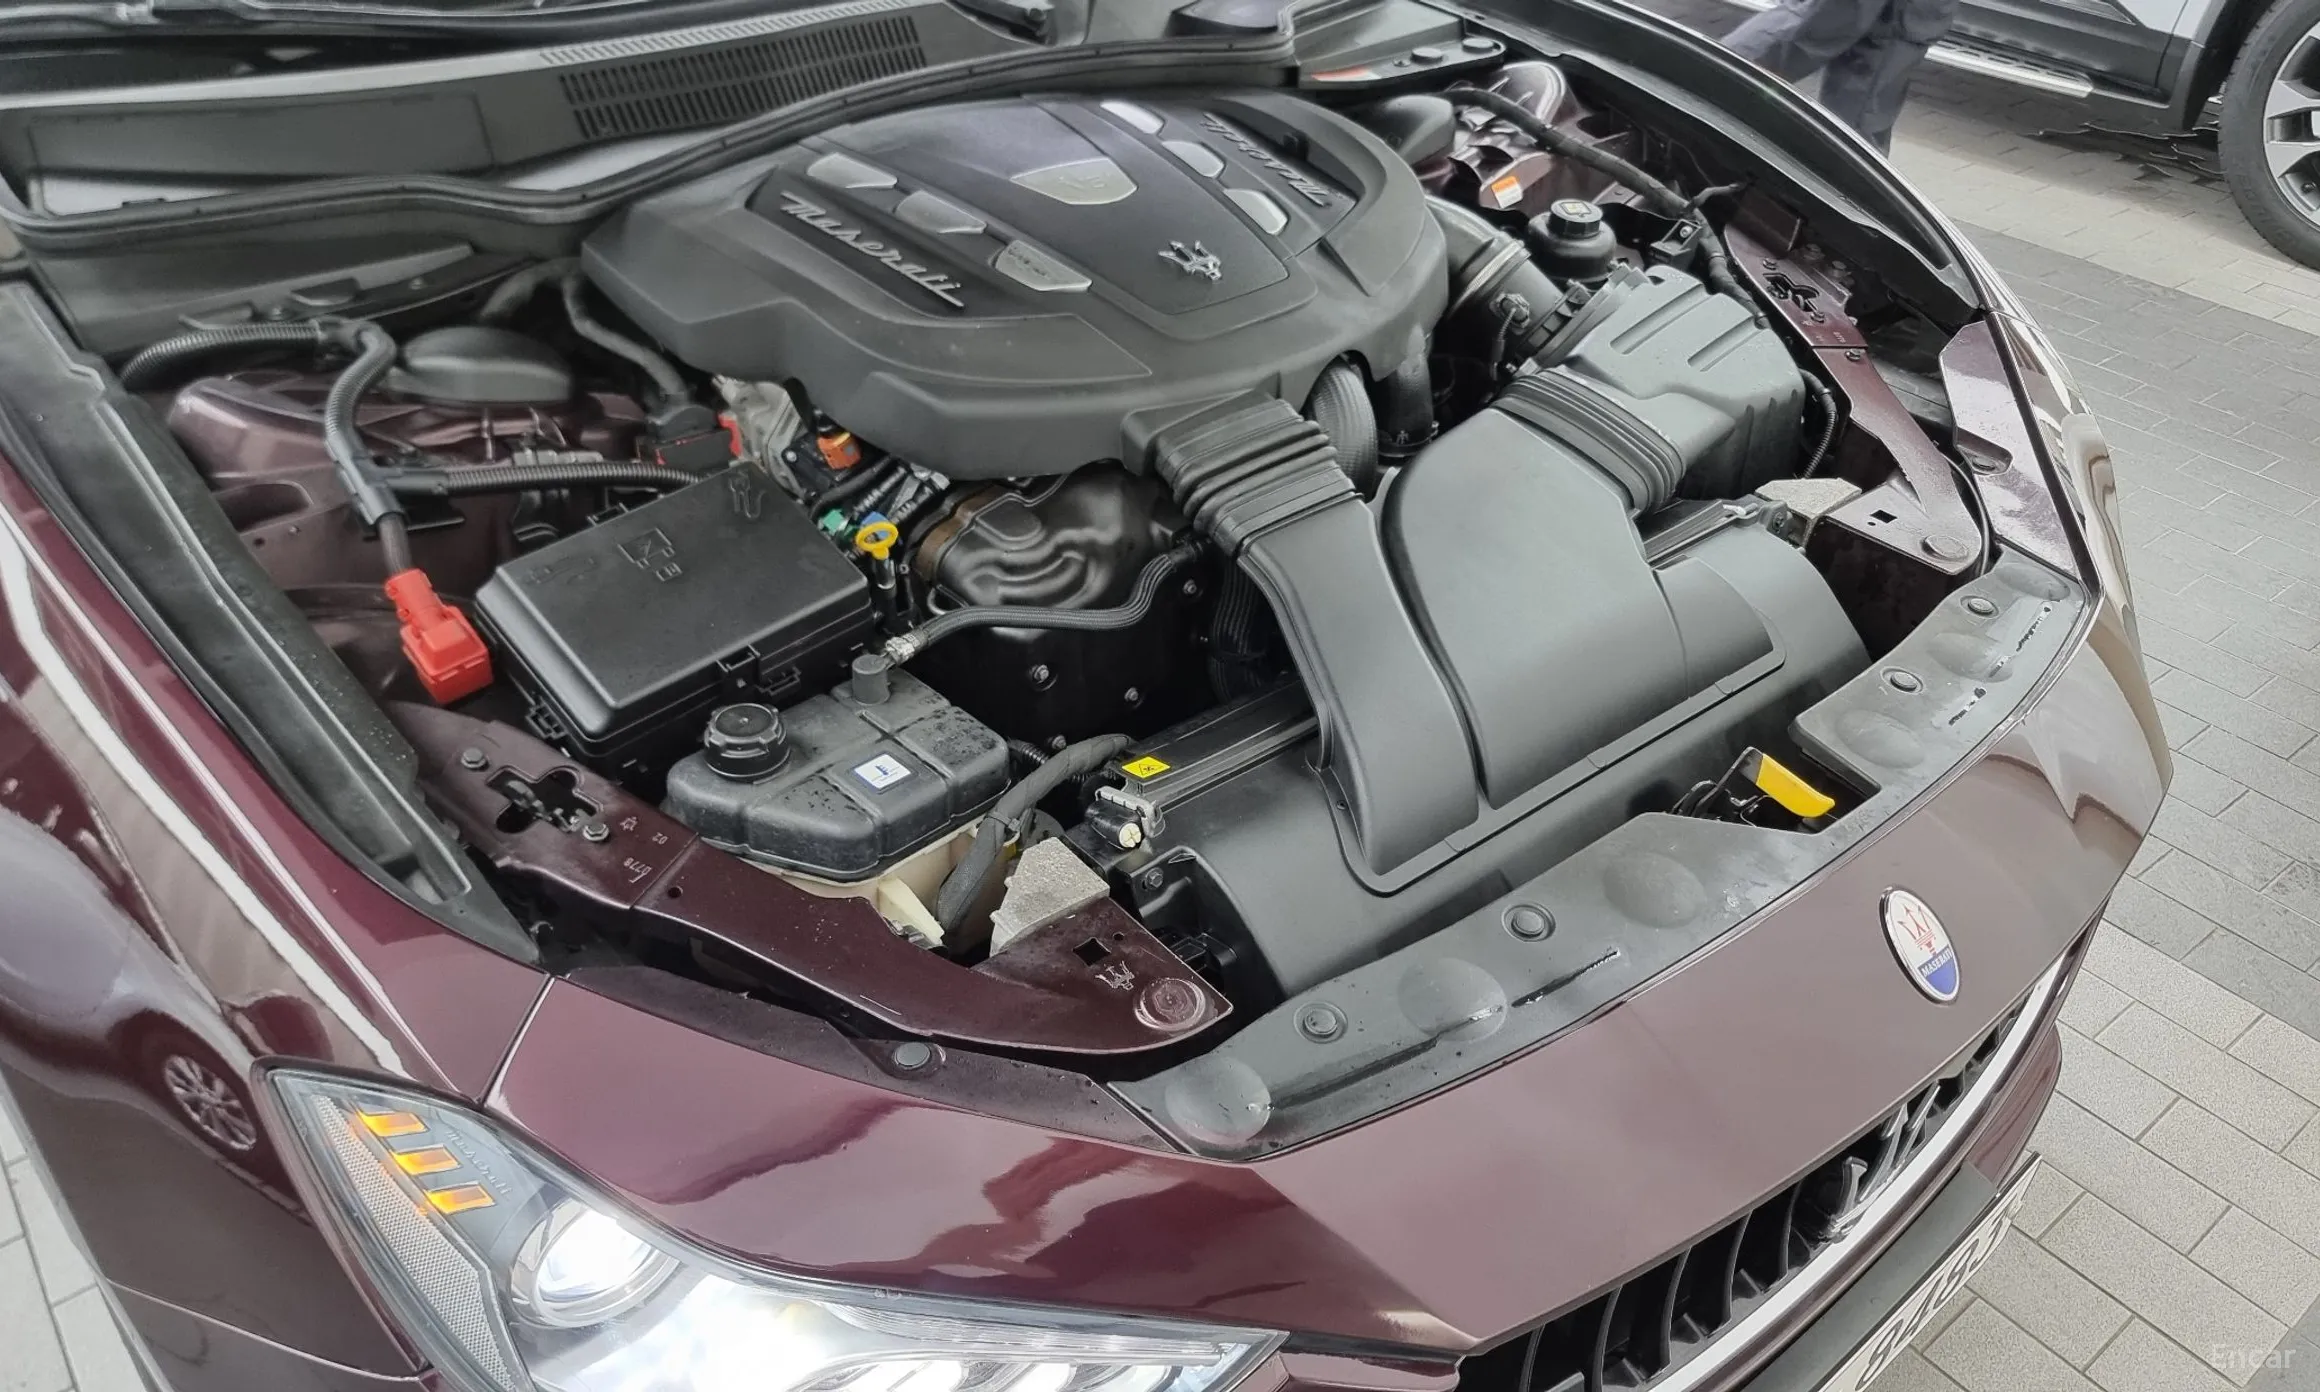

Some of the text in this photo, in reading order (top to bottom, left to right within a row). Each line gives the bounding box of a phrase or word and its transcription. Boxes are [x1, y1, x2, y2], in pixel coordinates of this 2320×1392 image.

[780, 190, 965, 307] Maserati
[1920, 947, 1954, 979] MASERATI
[1854, 1192, 2017, 1391] 8483
